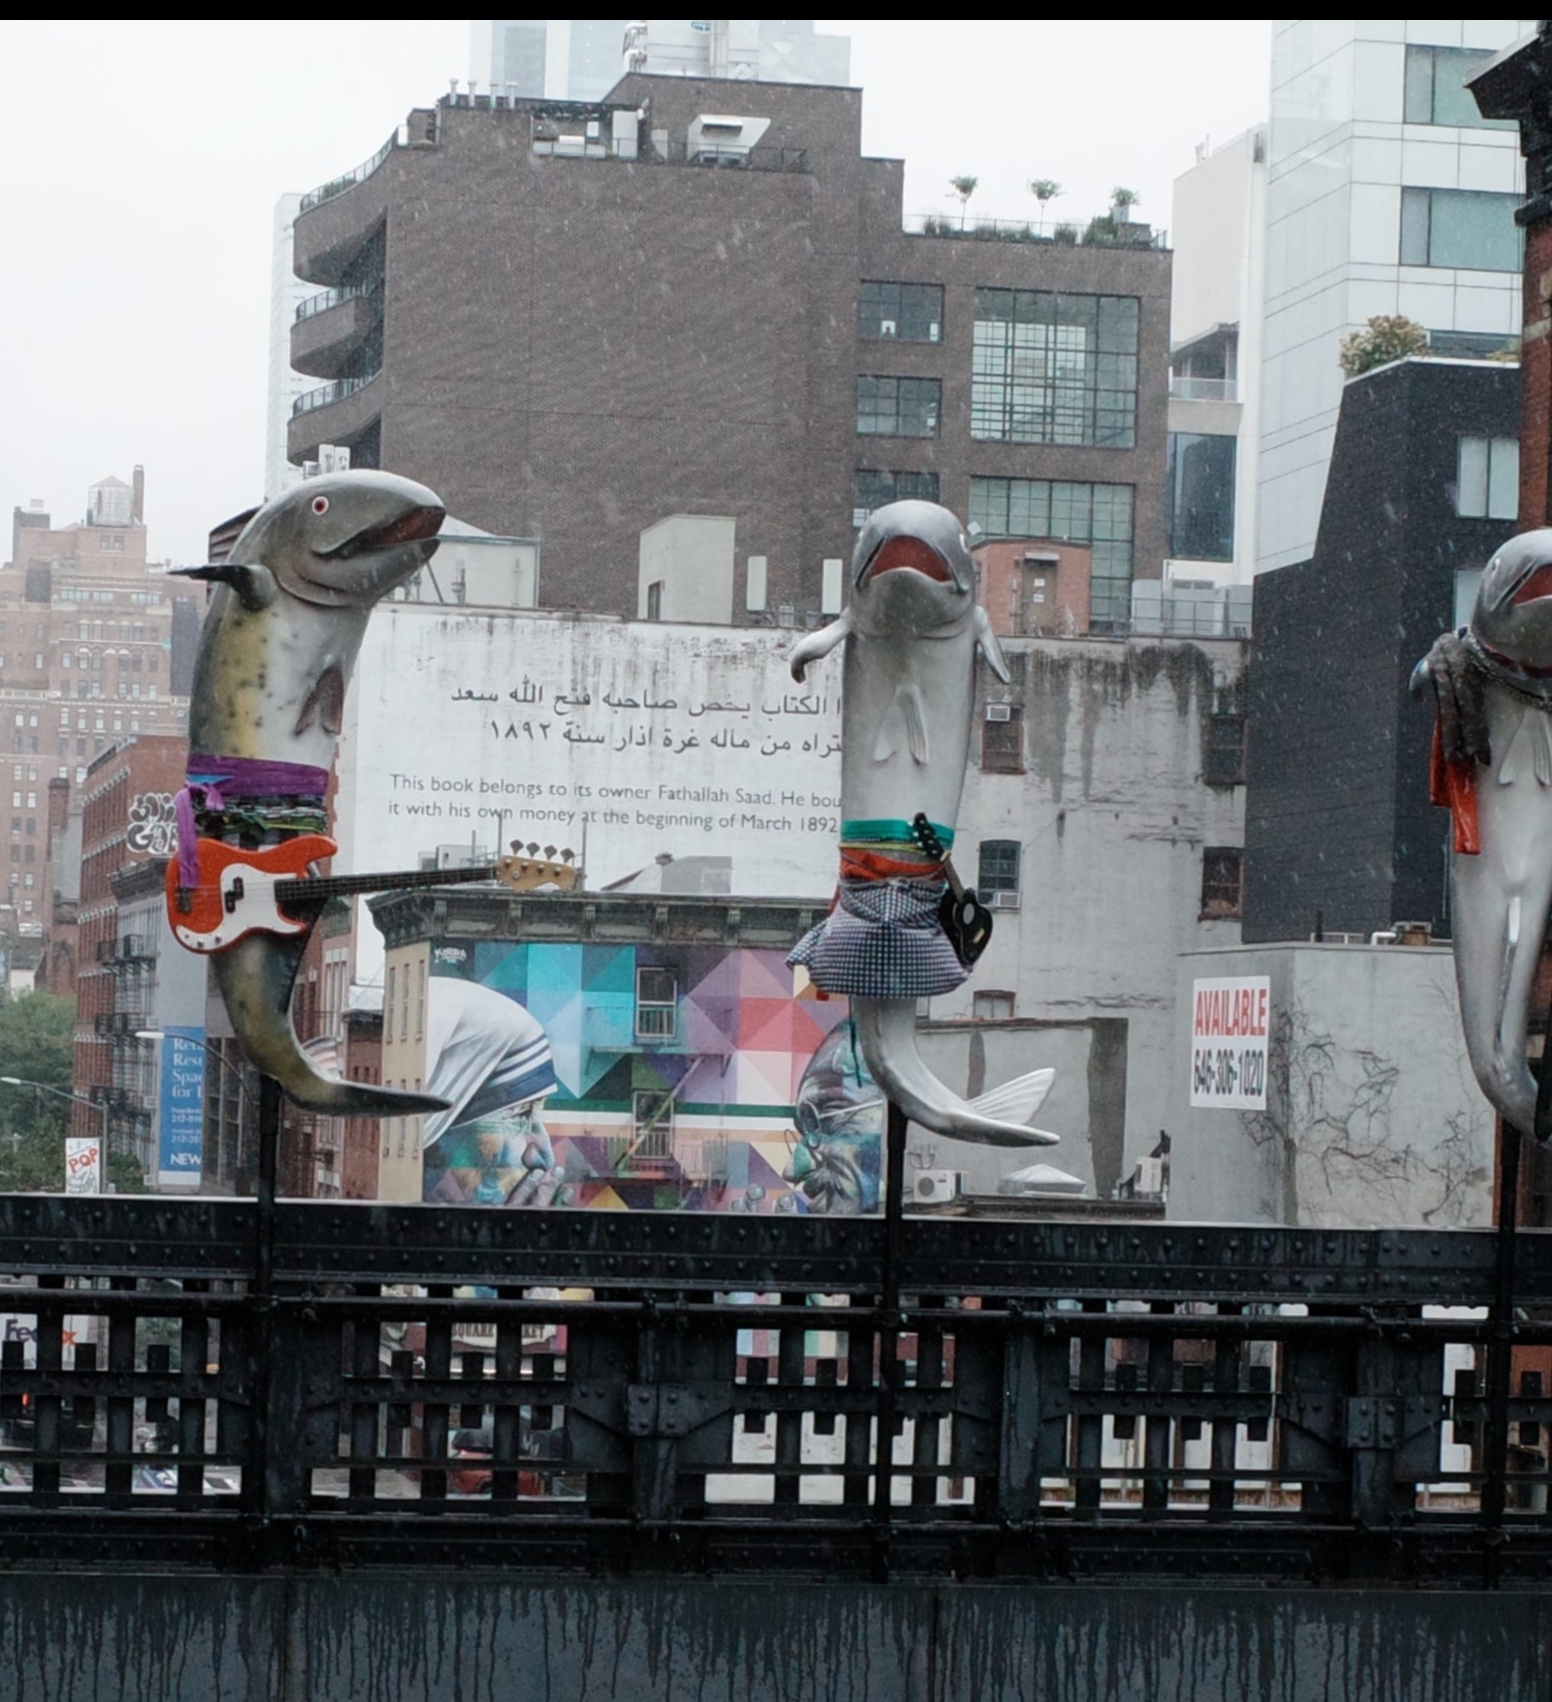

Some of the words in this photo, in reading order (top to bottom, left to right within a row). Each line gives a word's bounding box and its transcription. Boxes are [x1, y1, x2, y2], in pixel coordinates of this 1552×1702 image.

[450, 688, 499, 702] سعد
[553, 687, 591, 716] فتح
[602, 690, 678, 714] صاحبه
[689, 694, 751, 719] يخص
[762, 694, 827, 722] الكتاب
[490, 720, 551, 740] ١٨٩٢
[562, 721, 605, 744] سنة
[663, 729, 701, 754] غرة
[710, 728, 751, 748] ماله
[760, 735, 791, 756] من
[801, 733, 843, 758] تراه
[390, 773, 425, 791] This
[431, 776, 474, 793] book
[479, 778, 543, 800] belongs
[548, 783, 568, 797] to
[573, 782, 592, 797] its
[598, 786, 652, 800] owner
[657, 784, 729, 803] Fathallah
[735, 788, 776, 805] Saad.
[781, 791, 806, 807] He
[811, 792, 842, 808] bou
[389, 800, 400, 815] it
[406, 801, 442, 817] with
[449, 801, 471, 818] his
[477, 807, 513, 819] own
[519, 809, 576, 826] money
[581, 810, 597, 823] at
[603, 809, 630, 825] the
[636, 810, 713, 832] beginning
[718, 813, 736, 828] of
[741, 814, 792, 831] March
[800, 816, 838, 833] 1892
[1195, 988, 1267, 1036] AVAILABLE
[1194, 1048, 1264, 1097] 646-306-1020
[172, 1084, 191, 1098] for
[68, 1147, 98, 1174] POP
